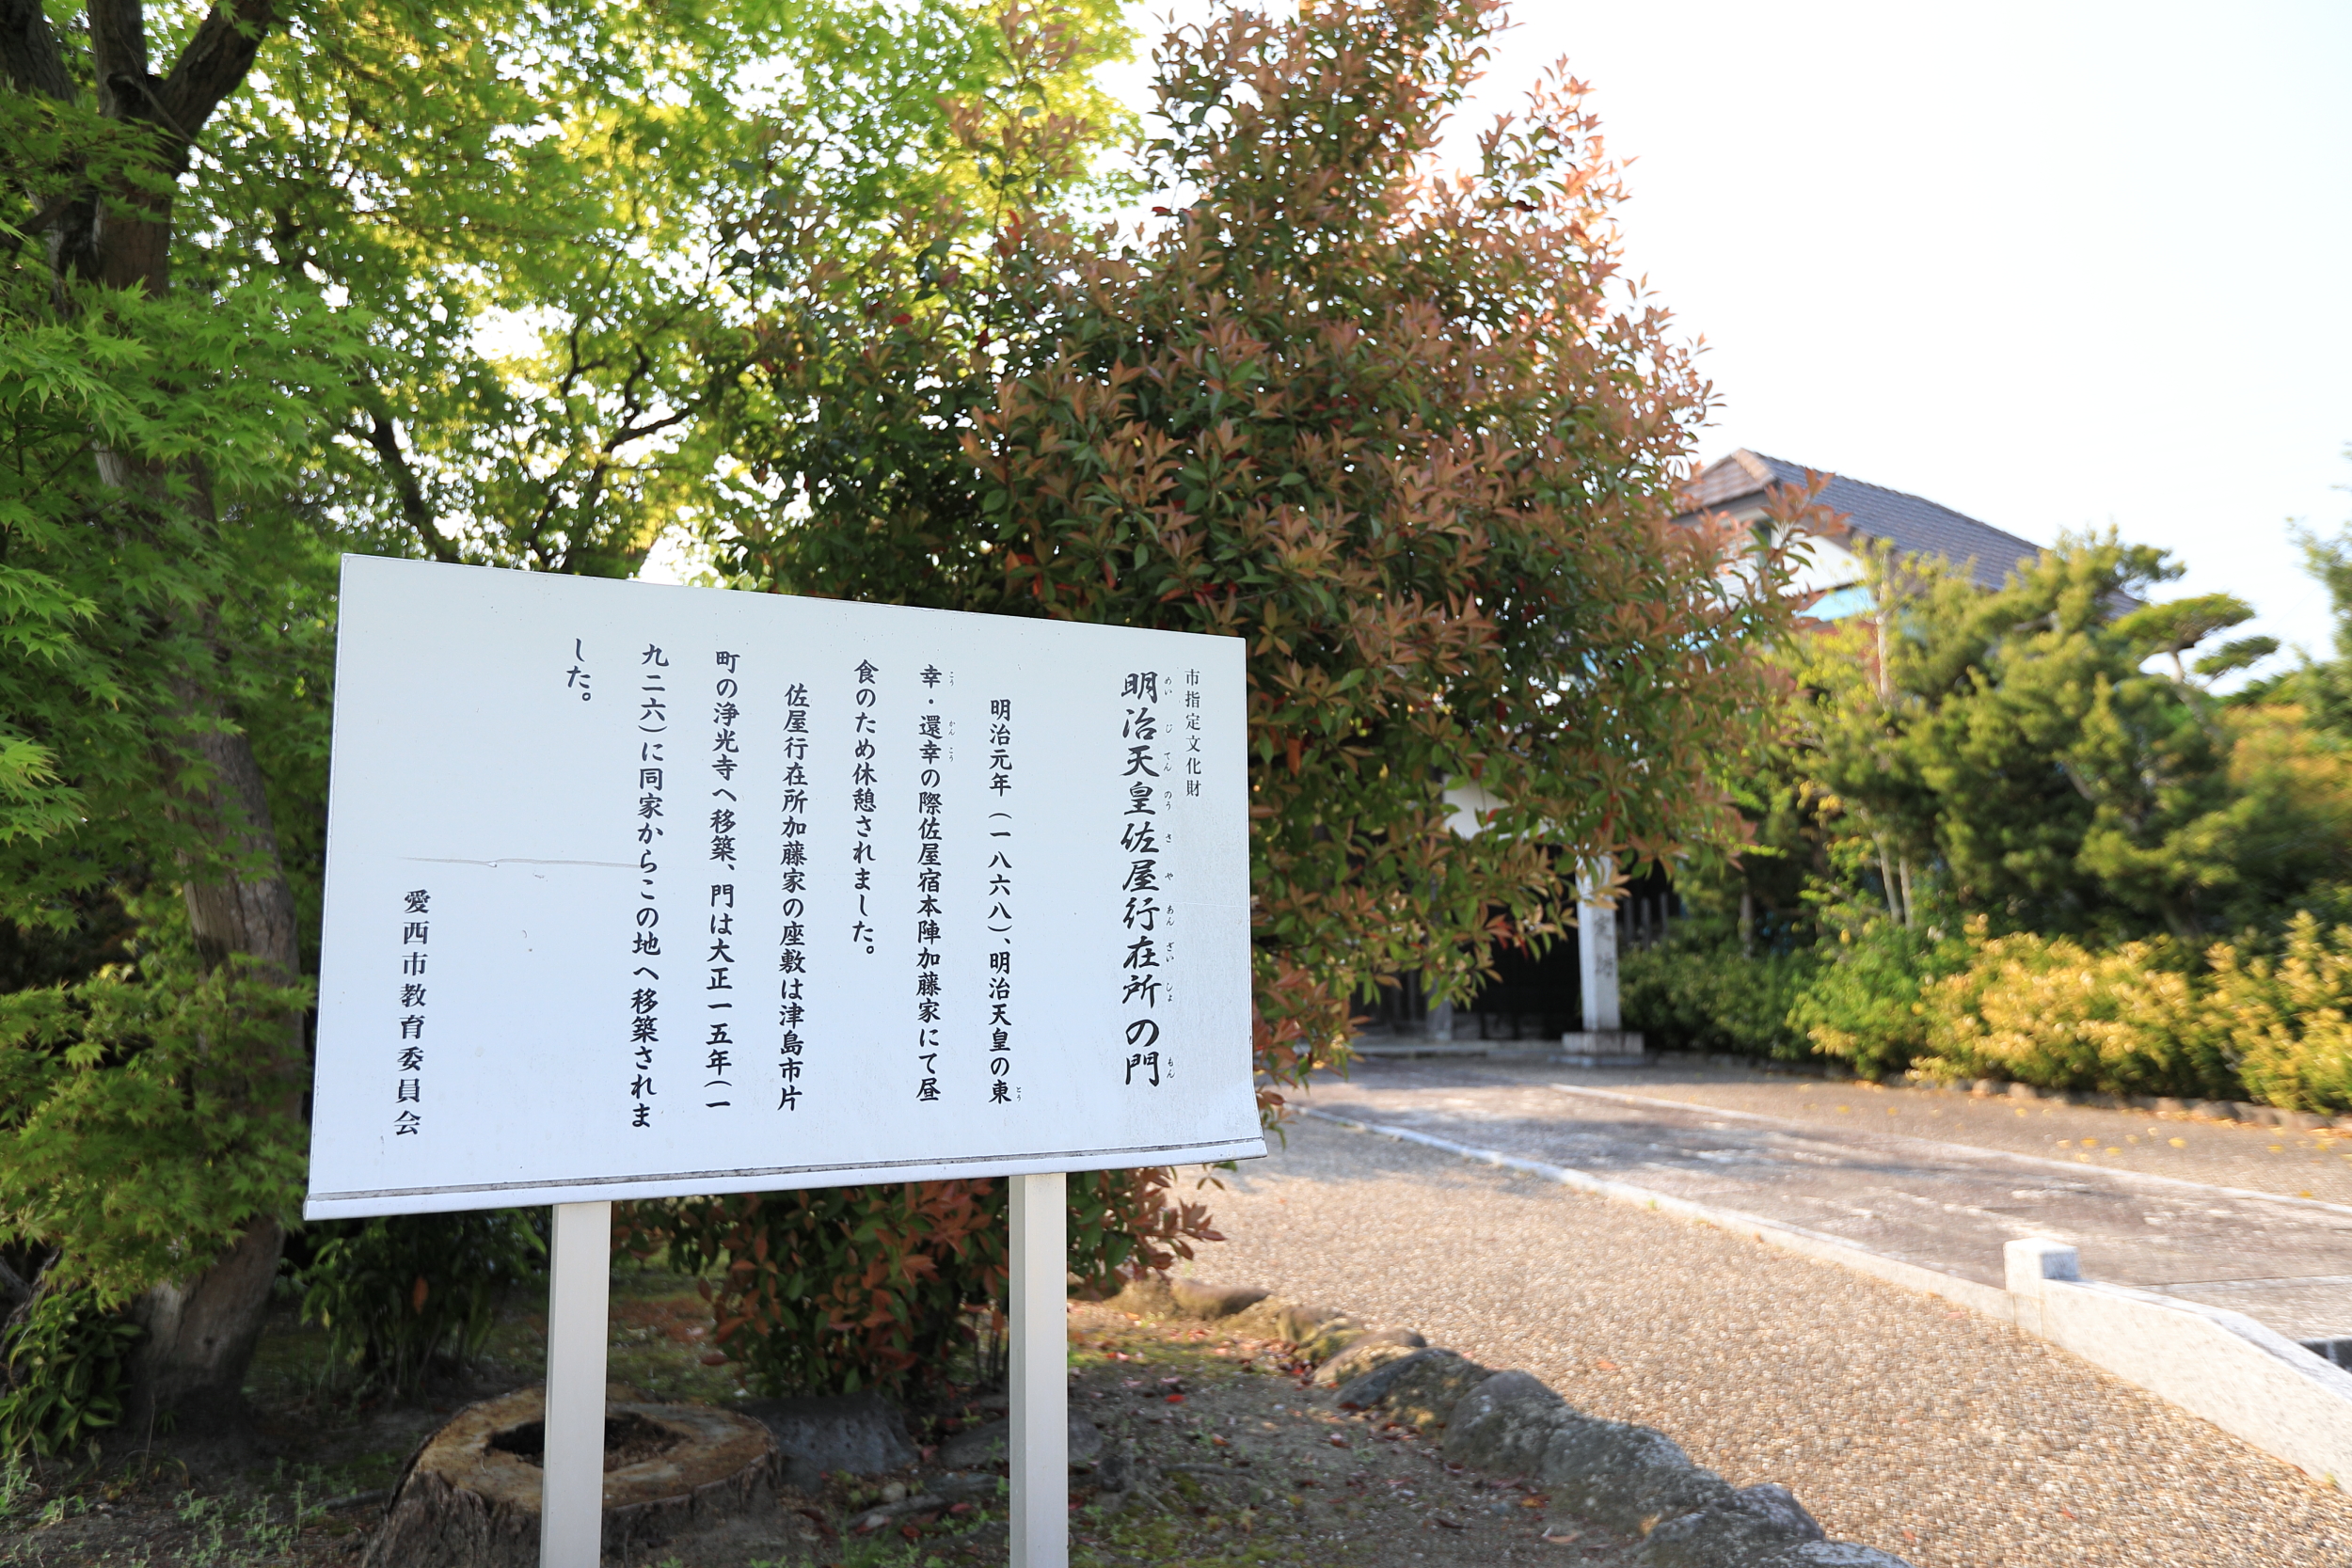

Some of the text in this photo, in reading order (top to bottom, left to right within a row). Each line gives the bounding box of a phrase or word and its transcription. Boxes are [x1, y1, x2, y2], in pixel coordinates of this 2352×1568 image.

[565, 637, 592, 702] した。
[851, 658, 880, 955] 食のため休憩されました。
[1184, 669, 1202, 798] 市指定文化財
[393, 888, 432, 1136] 愛西市教育委員会
[629, 642, 670, 1129] 九二六）に同家からこの地へ移築されま
[777, 682, 810, 1112] 佐屋行在所加藤家の座敷は津島市片
[916, 663, 944, 1102] 幸・還幸の際佐屋宿本陣加藤家にて昼
[1120, 671, 1162, 1087] 明治天皇佐屋行在所の門
